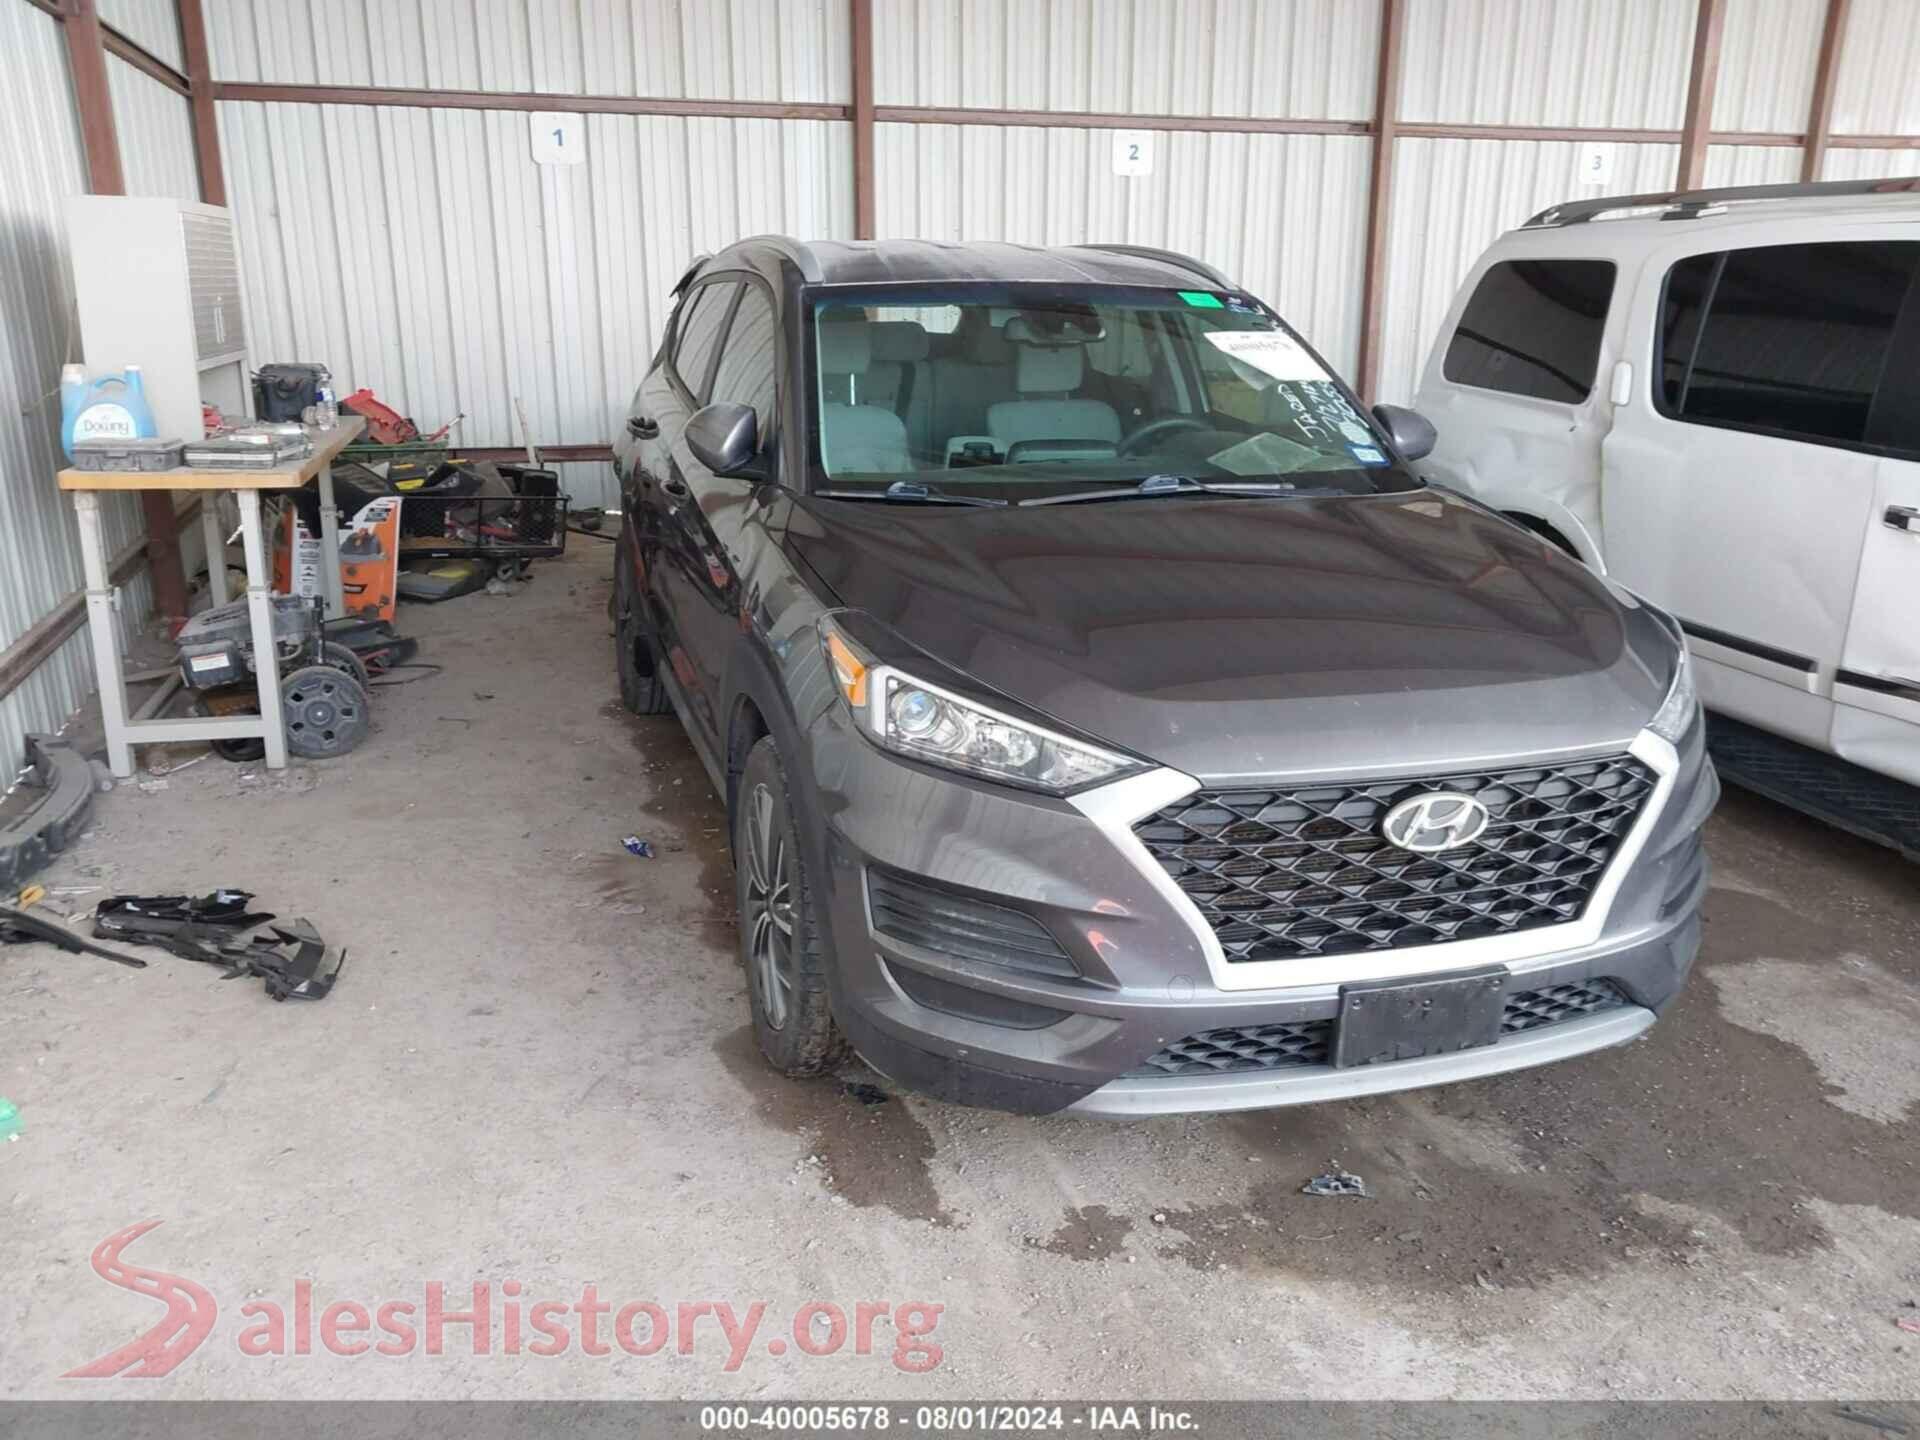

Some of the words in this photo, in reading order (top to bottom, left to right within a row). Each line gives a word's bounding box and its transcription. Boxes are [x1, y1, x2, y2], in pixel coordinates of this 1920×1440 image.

[551, 127, 563, 147] 1
[1128, 143, 1140, 161] 2
[1591, 154, 1602, 171] 3
[83, 419, 129, 436] Downy
